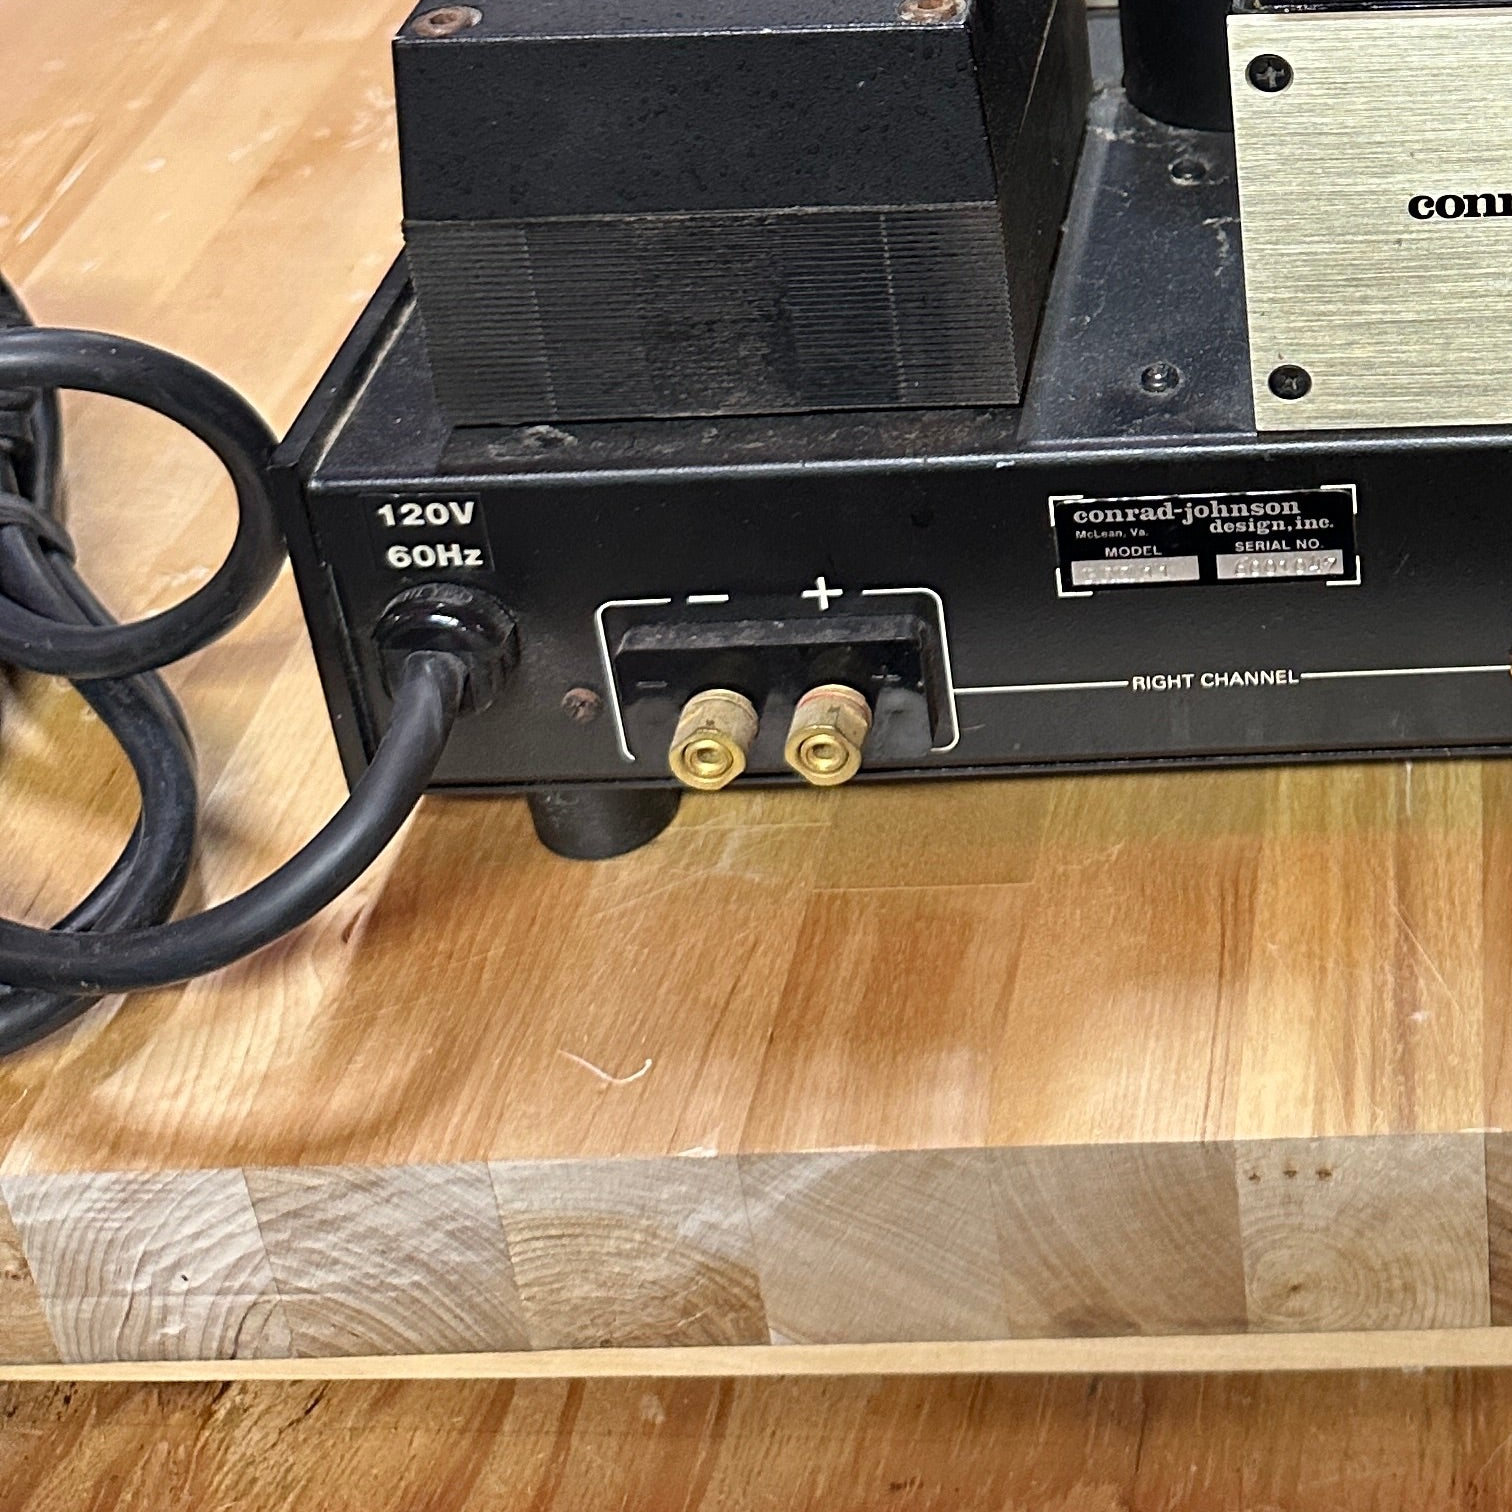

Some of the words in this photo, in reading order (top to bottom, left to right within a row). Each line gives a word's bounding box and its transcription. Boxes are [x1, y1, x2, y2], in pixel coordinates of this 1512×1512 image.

[377, 501, 475, 526] 120V
[1073, 500, 1301, 525] conrad-johnson
[386, 543, 484, 569] 60Hz
[1105, 545, 1163, 558] MODEL
[1234, 539, 1291, 553] SERIAL
[1296, 538, 1324, 550] NO.
[1132, 673, 1195, 691] RIGHT
[1200, 669, 1299, 688] CHANNEL
